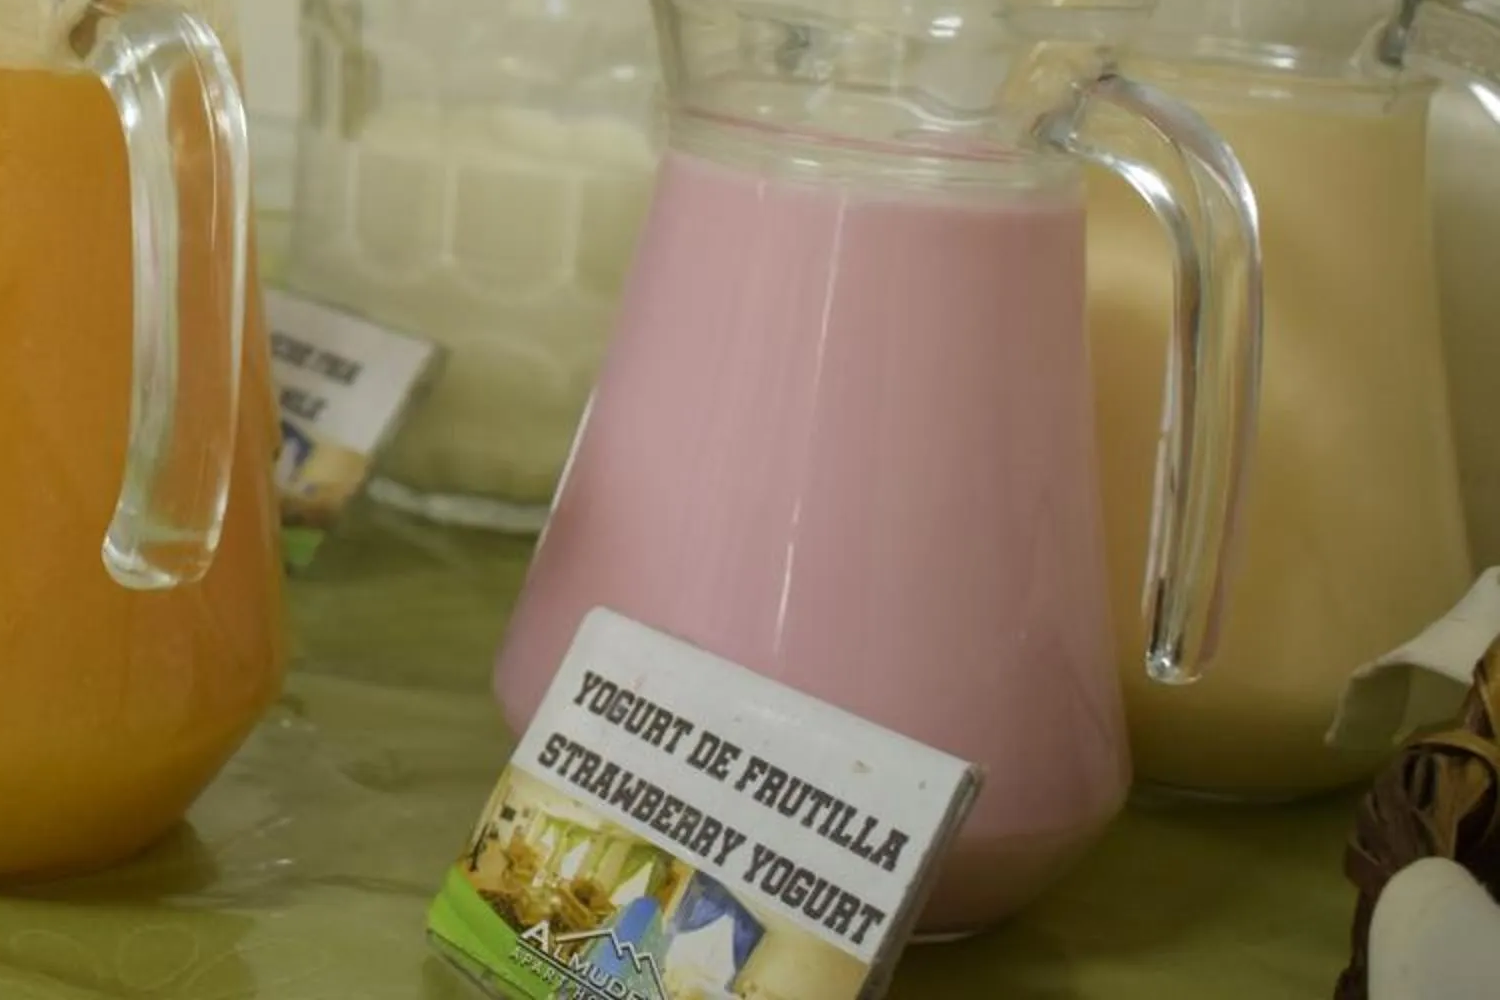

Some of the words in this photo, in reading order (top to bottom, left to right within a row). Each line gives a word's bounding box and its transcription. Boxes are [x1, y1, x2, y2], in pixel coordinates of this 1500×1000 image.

[538, 732, 747, 866] STRAWBERRY
[743, 842, 886, 945] YOGURT
[573, 670, 695, 755] YOGURT
[686, 730, 743, 781] DE
[734, 755, 910, 872] FRUTILLA
